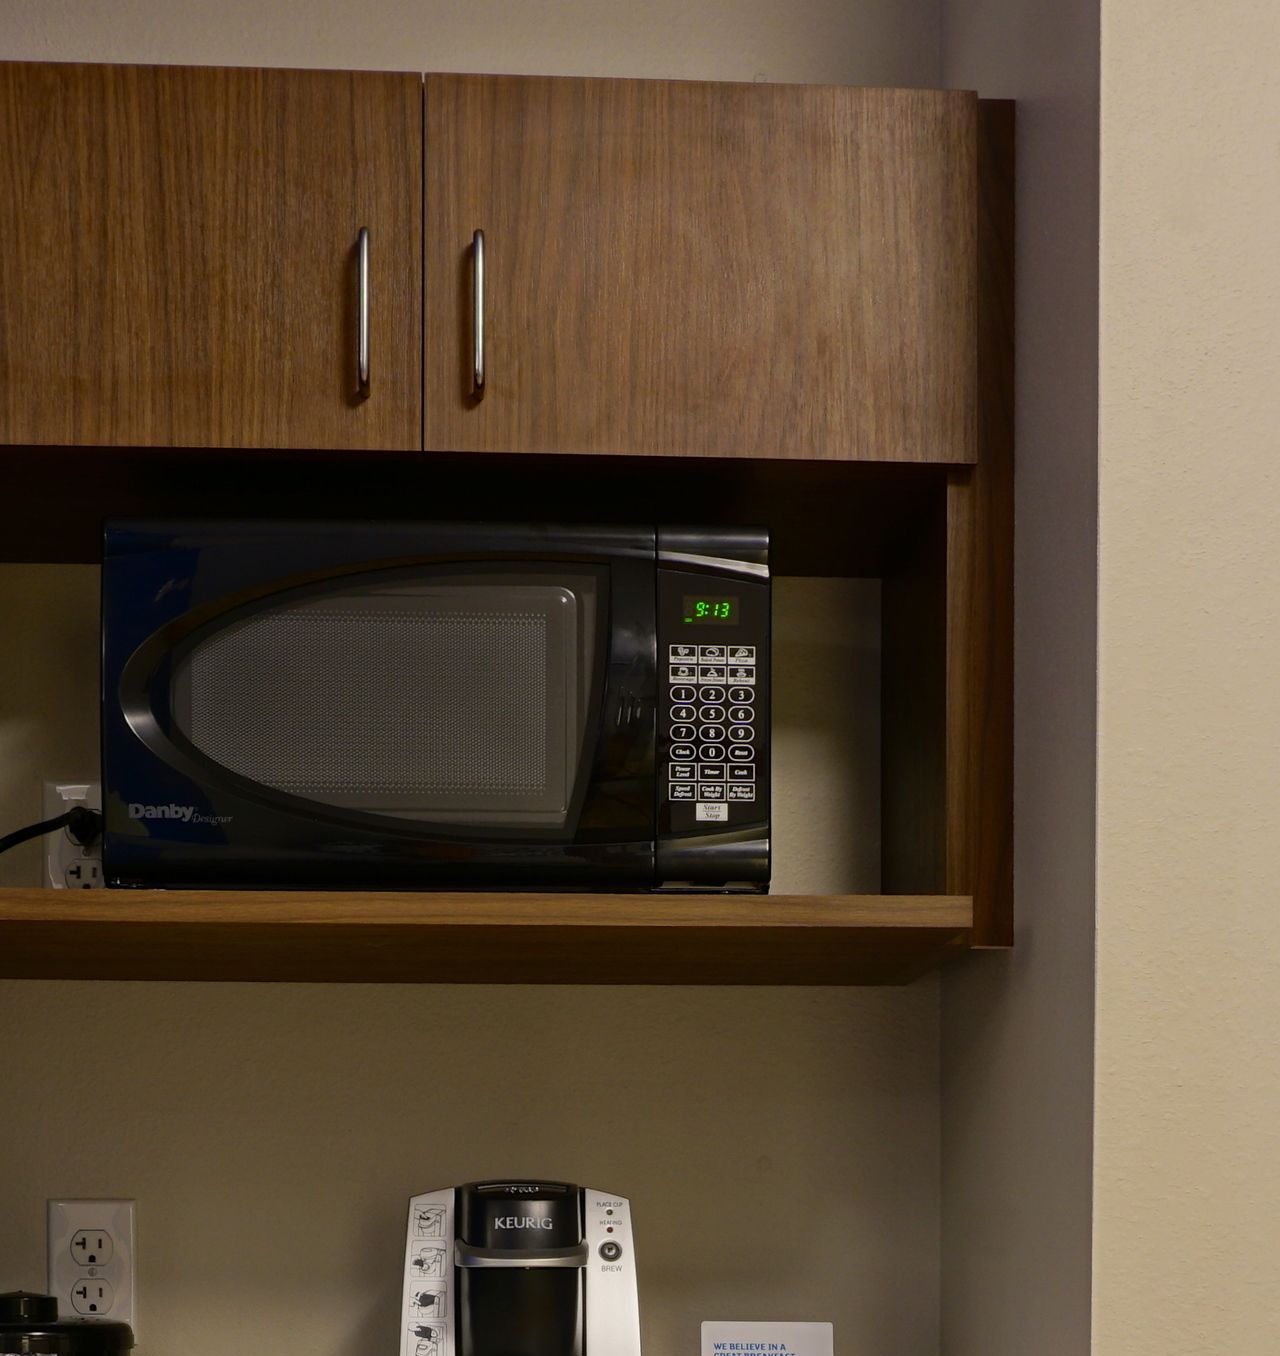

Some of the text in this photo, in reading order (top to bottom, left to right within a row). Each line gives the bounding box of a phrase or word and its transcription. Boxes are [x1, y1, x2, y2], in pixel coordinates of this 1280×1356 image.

[696, 602, 730, 618] 9:13
[681, 689, 686, 699] 1
[709, 690, 716, 699] 2
[738, 690, 745, 700] 3
[680, 708, 687, 718] 4
[709, 709, 716, 719] 5
[738, 710, 745, 719] 6
[680, 728, 687, 737] 7
[709, 728, 716, 738] 8
[738, 729, 745, 738] 9
[709, 747, 716, 757] 0
[128, 803, 194, 822] Danby
[494, 1216, 553, 1230] KEURIG
[713, 1343, 786, 1351] WE BELIEVE IN A
